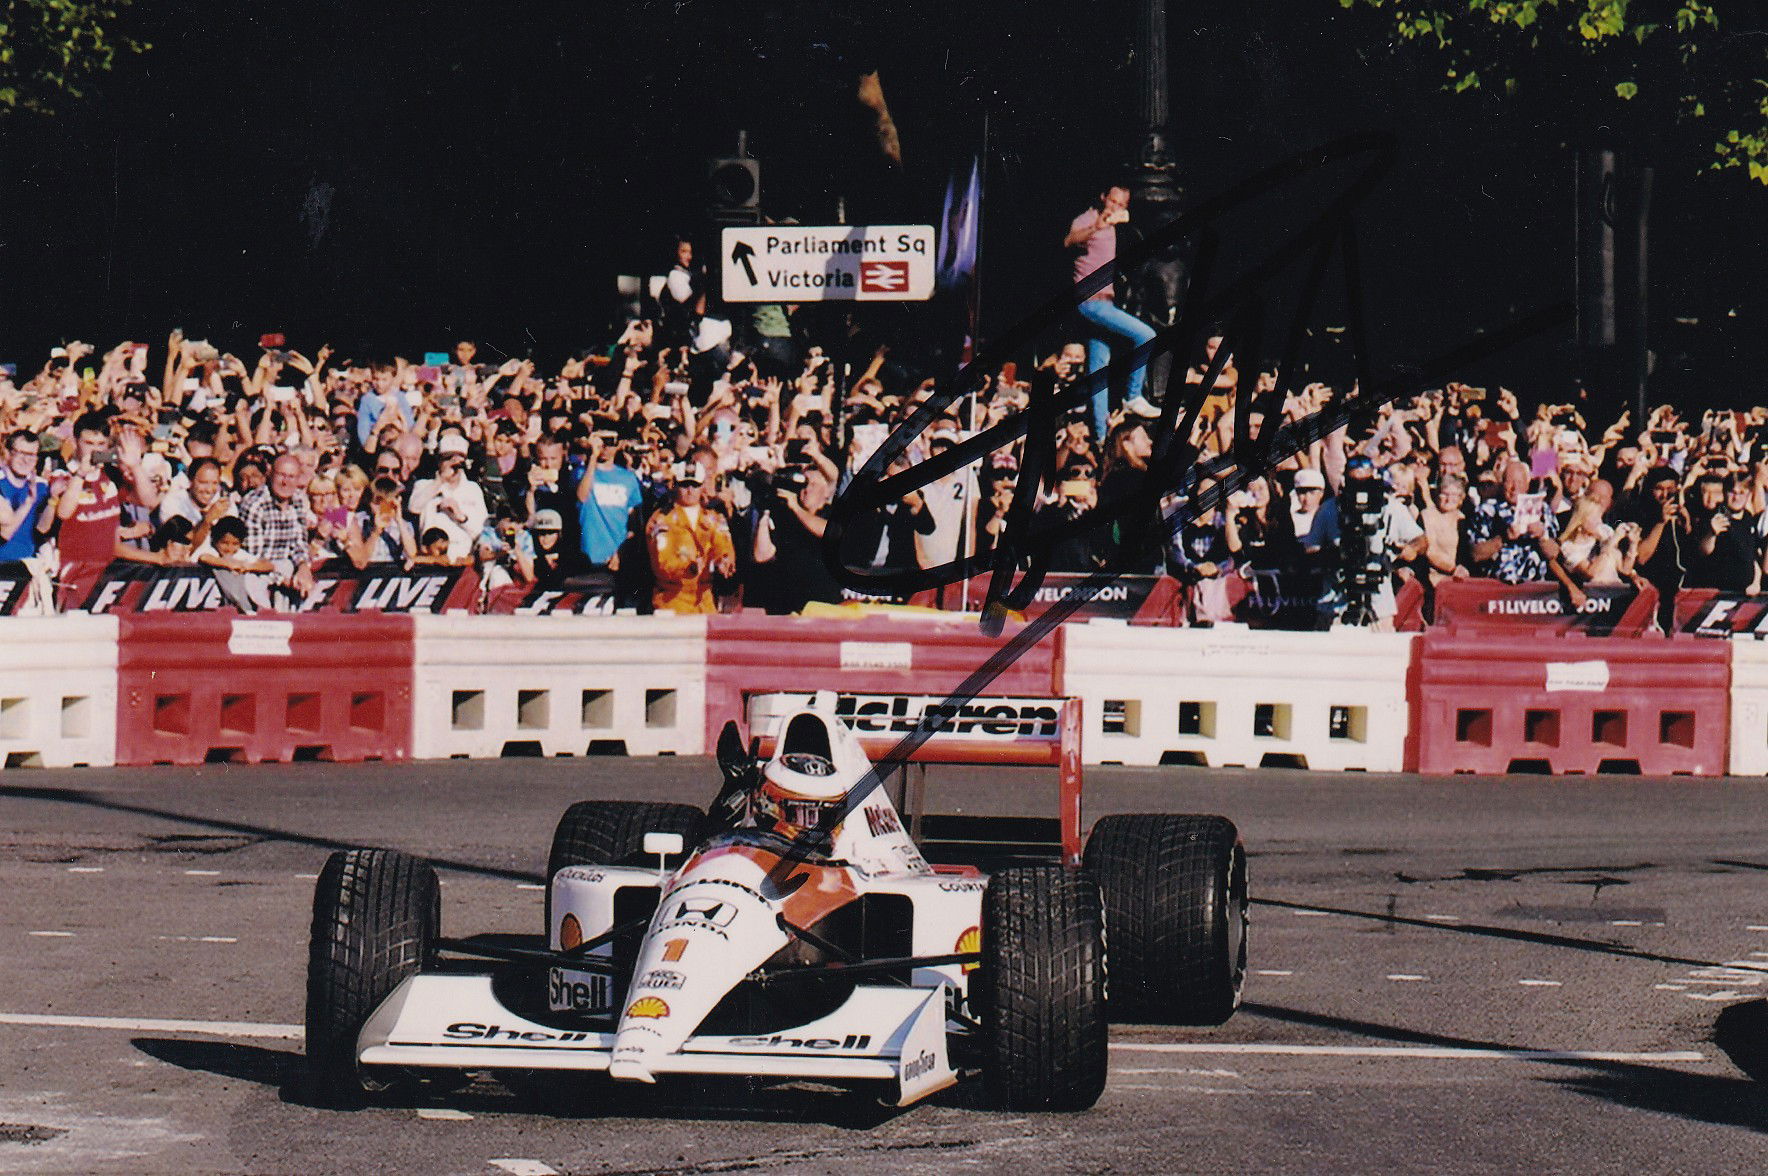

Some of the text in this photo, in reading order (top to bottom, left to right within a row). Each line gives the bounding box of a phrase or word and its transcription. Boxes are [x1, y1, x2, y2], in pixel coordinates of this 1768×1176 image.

[766, 234, 926, 255] Parliament Sq
[767, 269, 855, 288] Victoria
[952, 482, 963, 500] 2
[355, 576, 449, 609] LIVE
[1487, 598, 1612, 615] F1LIVELOON
[662, 938, 689, 962] 1
[551, 967, 607, 1009] Shell
[443, 1022, 588, 1041] Shell
[728, 1034, 872, 1050] Shell
